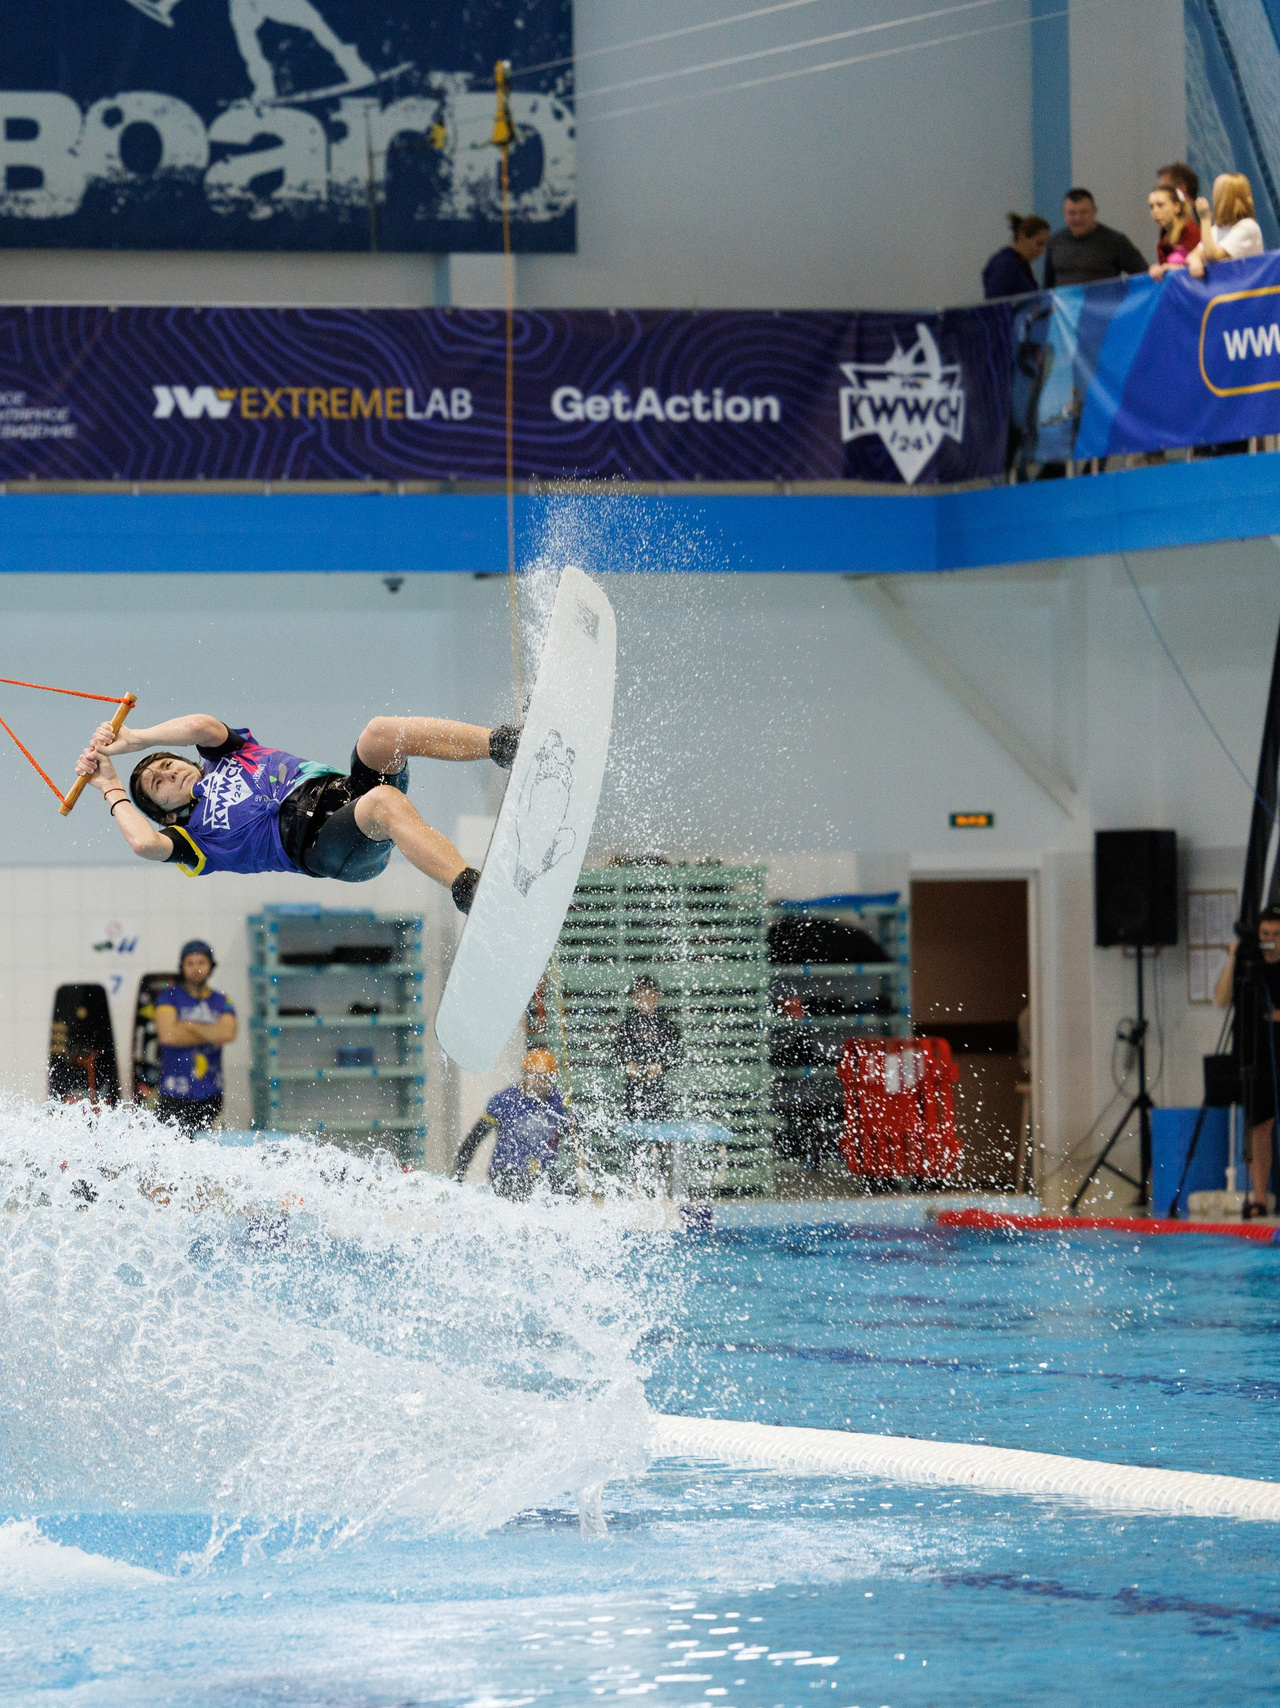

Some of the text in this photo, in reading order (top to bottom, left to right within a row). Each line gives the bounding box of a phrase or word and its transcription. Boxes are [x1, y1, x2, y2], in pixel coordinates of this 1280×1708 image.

[550, 386, 781, 423] GetAction
[848, 394, 961, 431] KWWCH
[109, 975, 123, 995] 7
